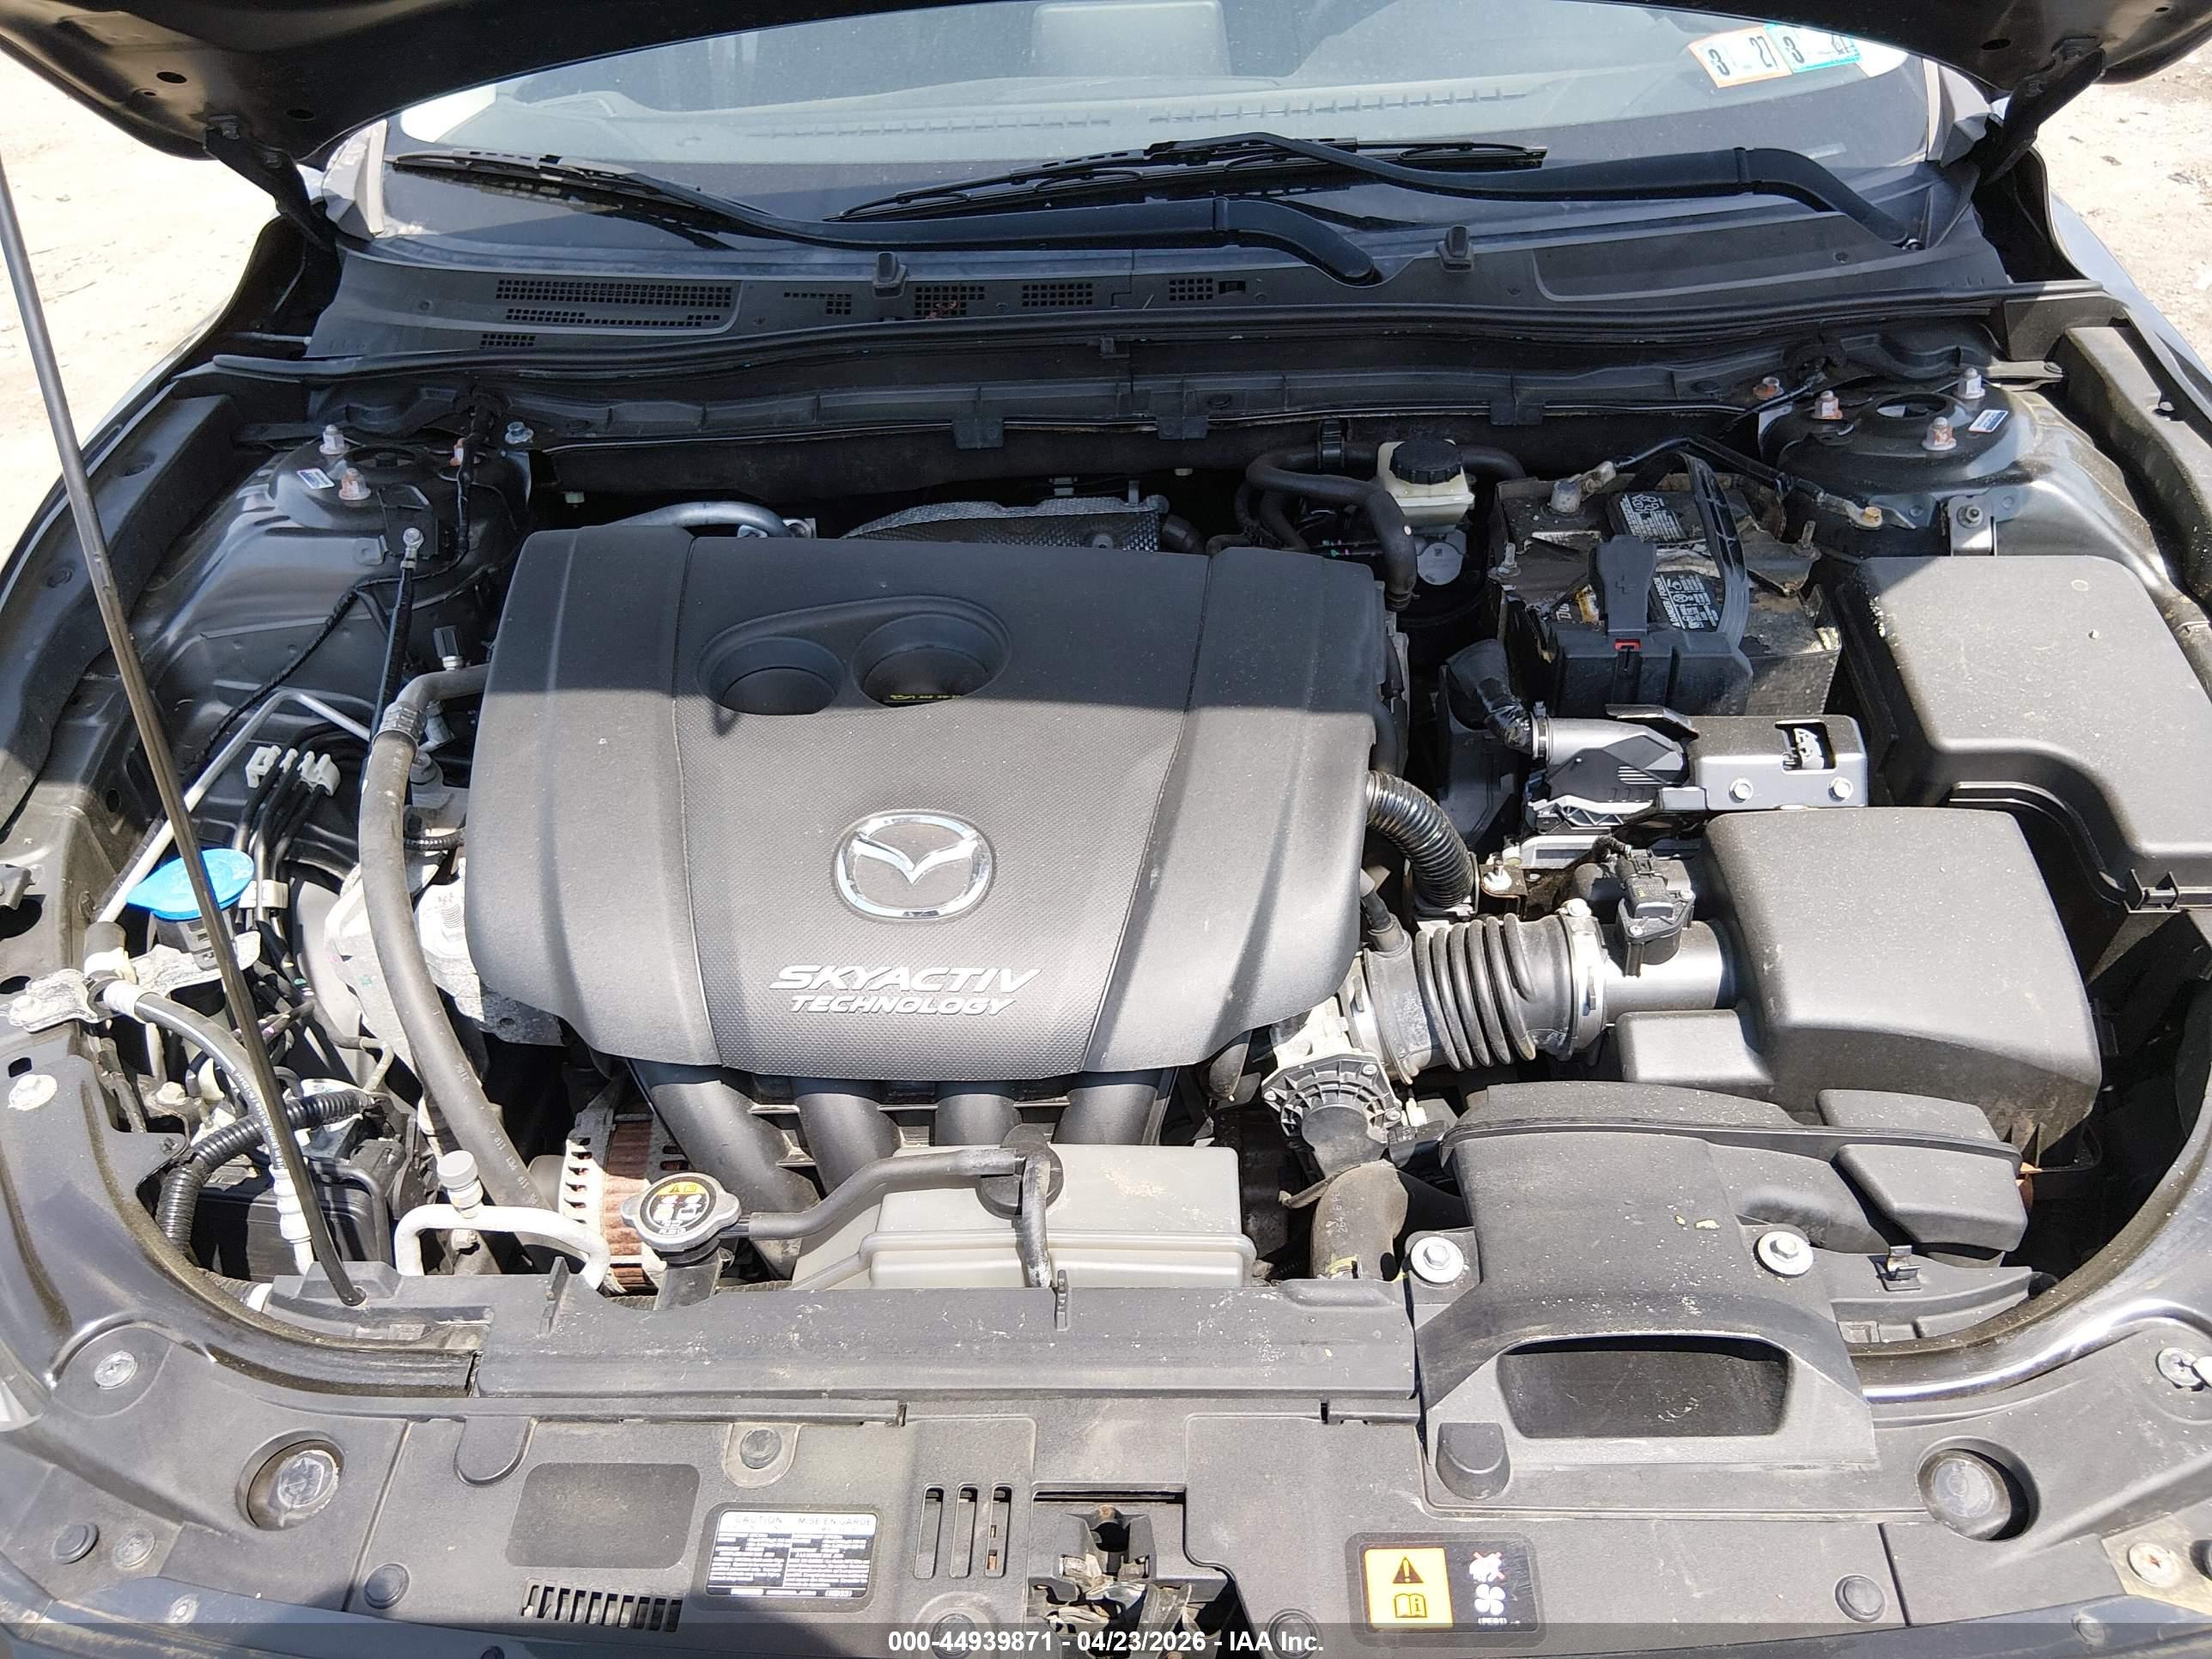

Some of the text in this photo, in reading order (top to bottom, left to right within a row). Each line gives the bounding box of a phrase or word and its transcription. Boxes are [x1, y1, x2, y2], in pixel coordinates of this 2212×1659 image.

[1708, 35, 1779, 76] 3 27
[1783, 36, 1804, 64] 3
[769, 964, 1043, 994] SKYACTIV
[790, 994, 1017, 1016] TECHNOLOGY
